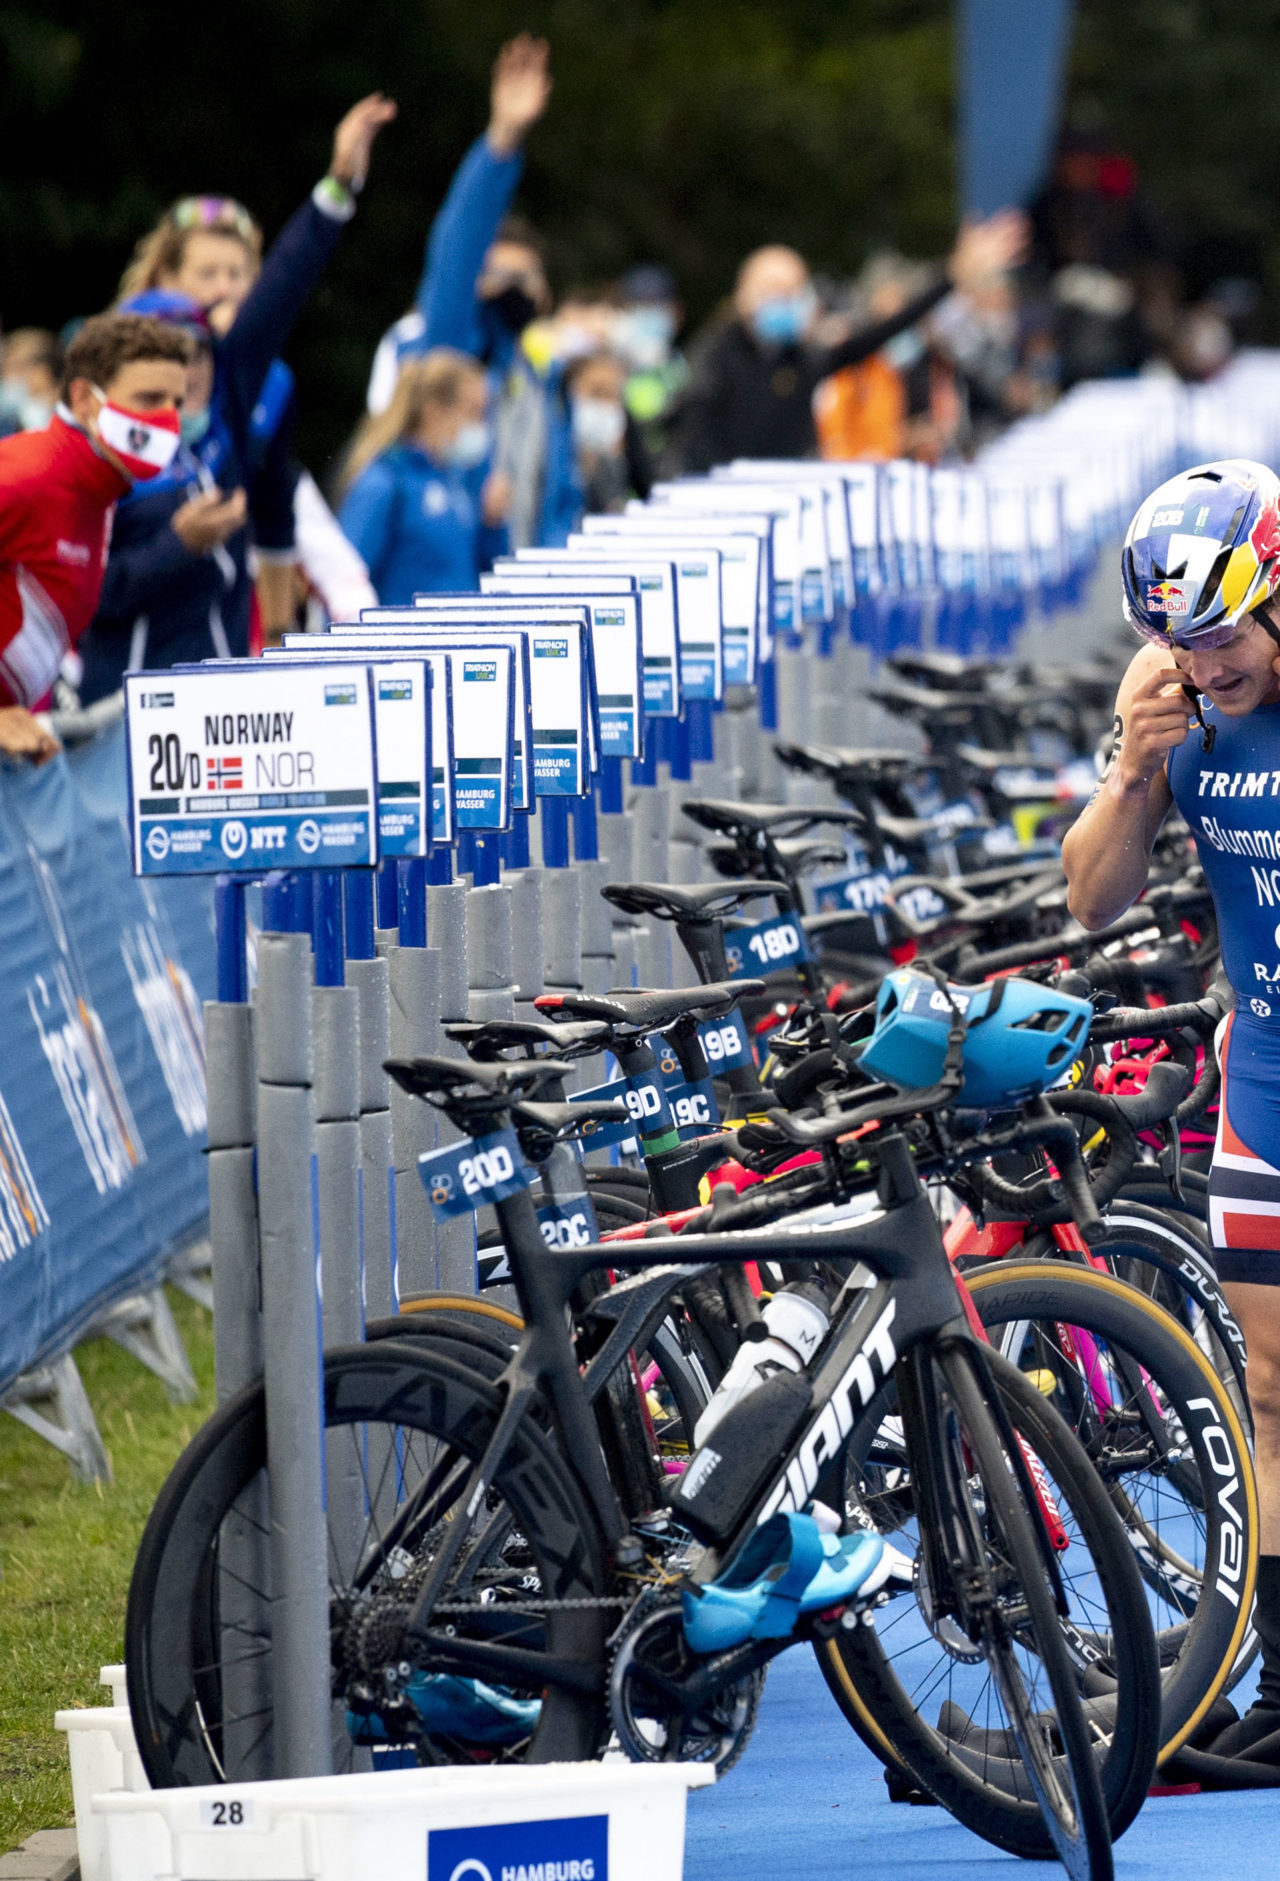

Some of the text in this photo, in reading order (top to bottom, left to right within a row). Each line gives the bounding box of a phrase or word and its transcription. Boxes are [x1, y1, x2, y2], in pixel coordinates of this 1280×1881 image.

[1147, 600, 1188, 612] Red Bull
[464, 664, 496, 672] TRIATHLON
[204, 711, 294, 746] NORWAY
[255, 751, 316, 788] NOR
[250, 826, 288, 849] NTT
[749, 924, 800, 963] 18D
[458, 1146, 515, 1195] 20D
[540, 1213, 590, 1248] 20C
[1178, 1257, 1248, 1368] DURA-
[212, 1802, 244, 1825] 28
[501, 1859, 594, 1881] HAMBURG
